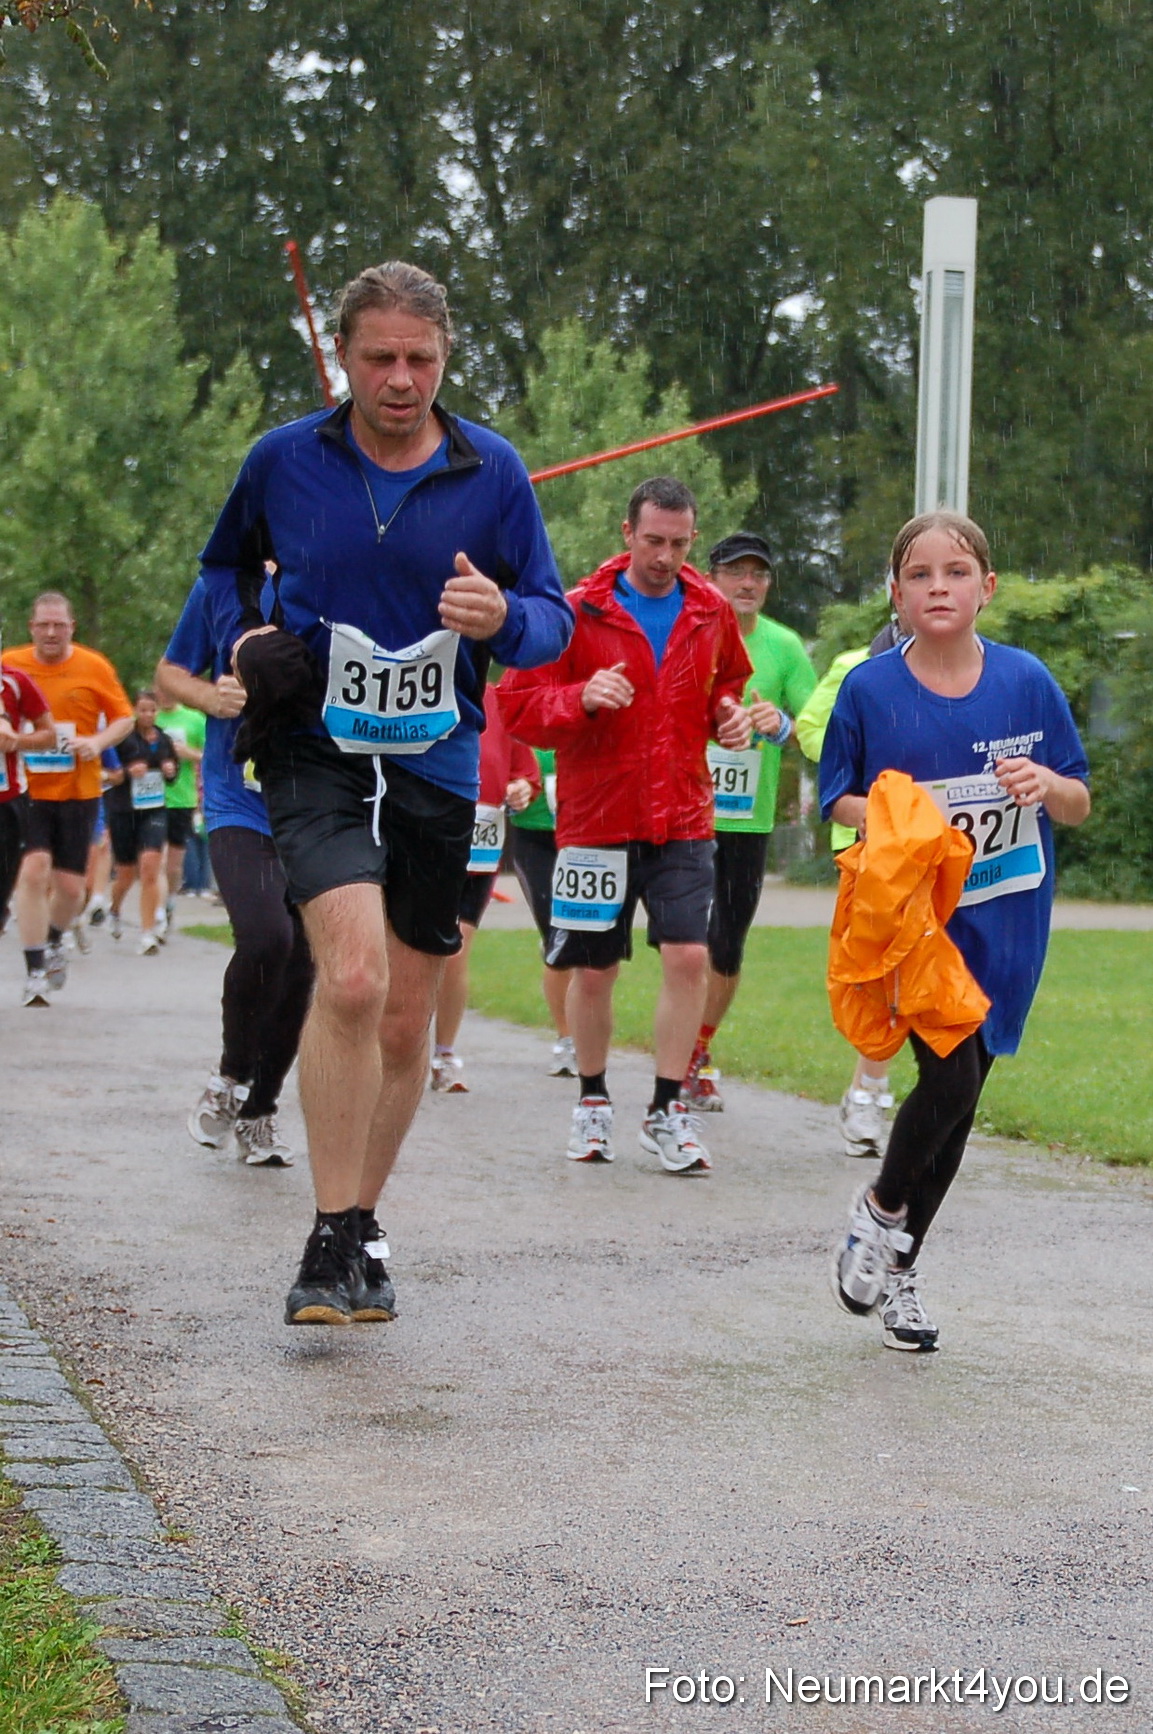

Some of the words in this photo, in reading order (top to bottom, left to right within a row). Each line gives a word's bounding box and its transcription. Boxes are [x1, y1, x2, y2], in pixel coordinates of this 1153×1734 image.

[341, 660, 443, 713] 3159
[352, 718, 429, 740] Matthias
[555, 867, 617, 900] 2936
[963, 864, 1003, 888] onja
[561, 904, 600, 919] Florian
